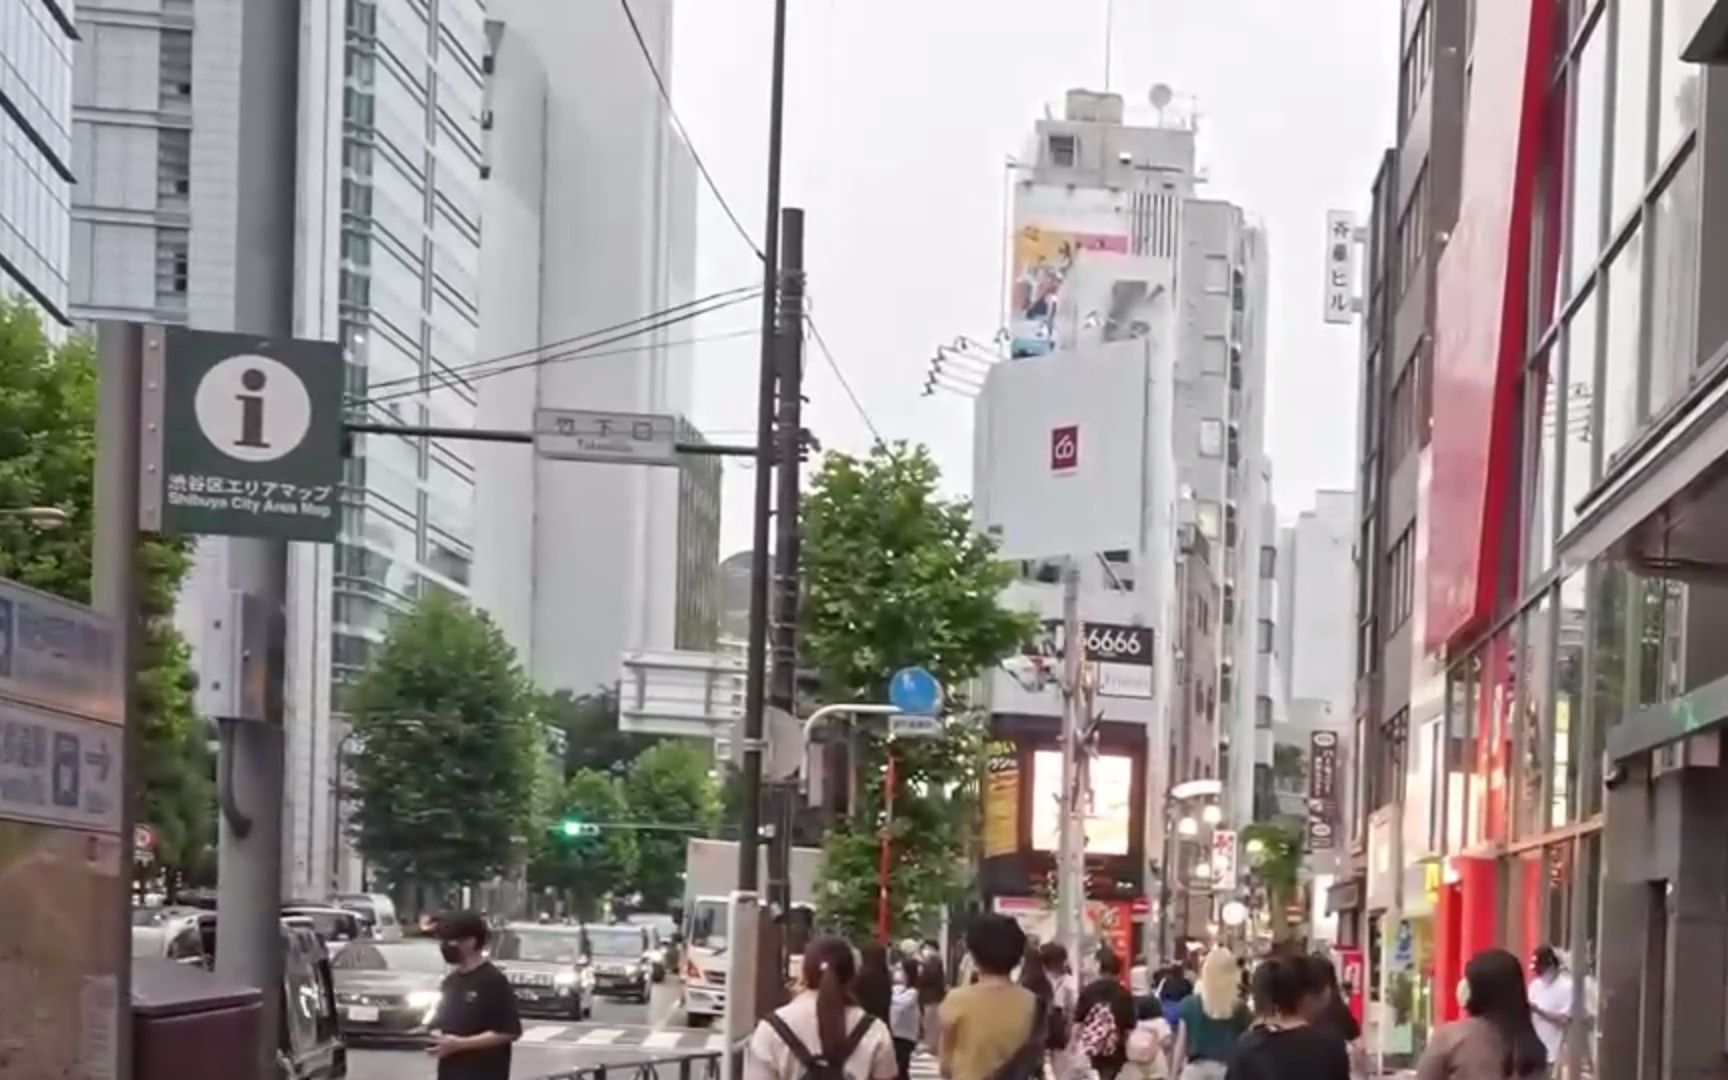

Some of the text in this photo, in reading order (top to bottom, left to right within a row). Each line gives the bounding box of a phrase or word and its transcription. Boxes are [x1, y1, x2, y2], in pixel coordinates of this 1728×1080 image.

[168, 473, 332, 501] 渋谷区エリアマップ
[168, 491, 331, 518] Shibuya City Area Map
